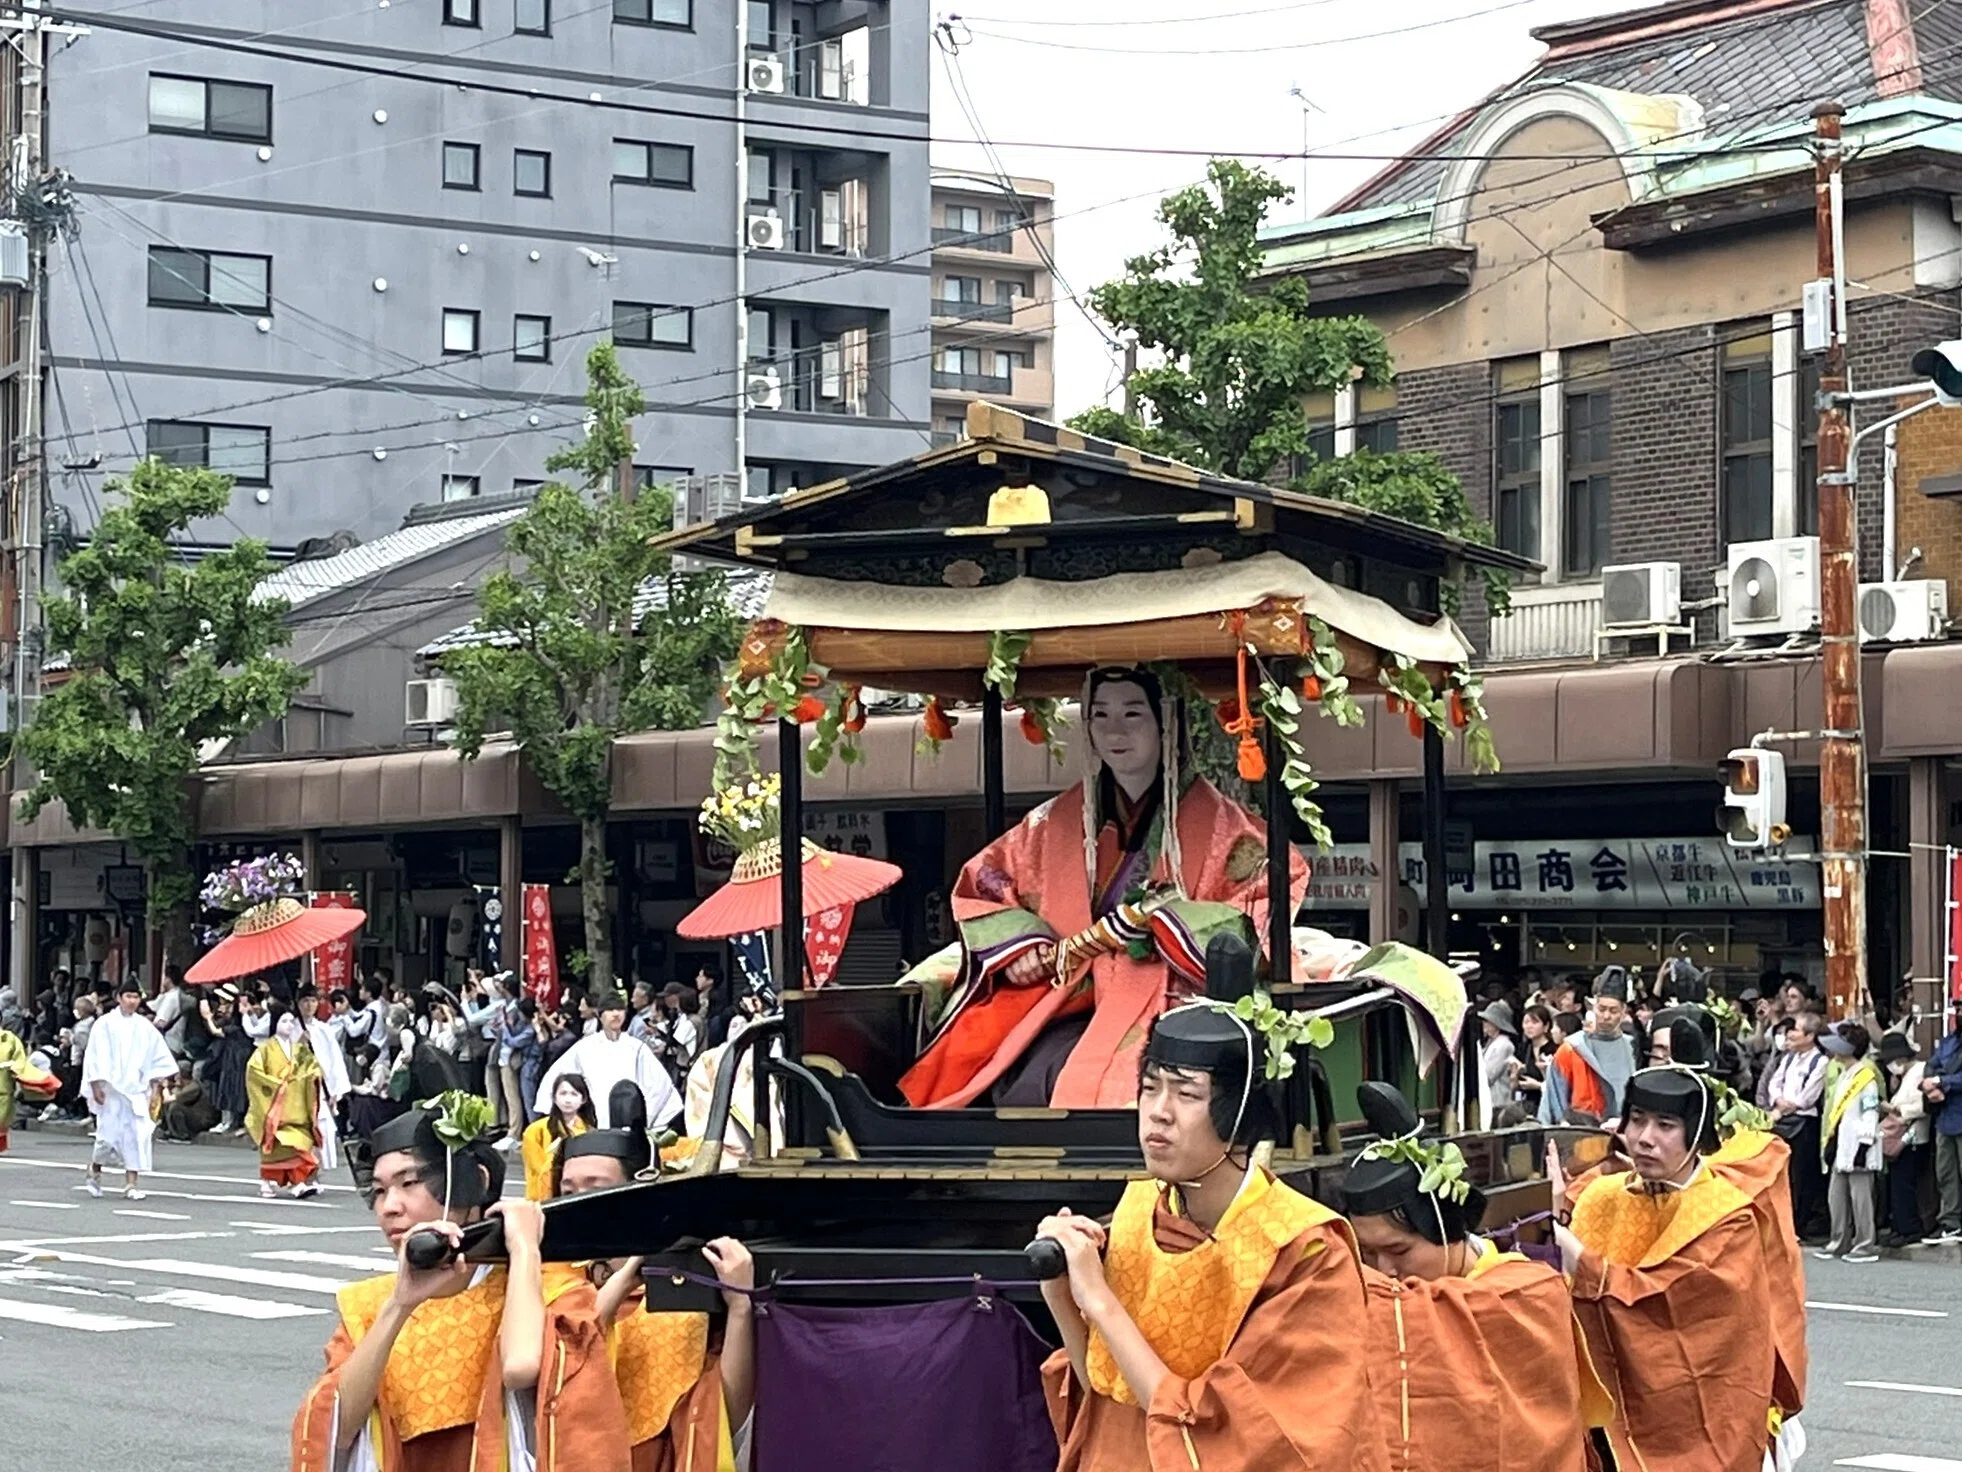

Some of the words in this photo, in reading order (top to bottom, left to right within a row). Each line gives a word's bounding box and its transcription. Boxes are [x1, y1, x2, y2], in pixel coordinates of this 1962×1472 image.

[1656, 842, 1702, 862] 京都牛
[1670, 864, 1718, 882] 近江牛
[1750, 870, 1791, 886] 鹿児島
[1686, 884, 1735, 903] 神戸牛
